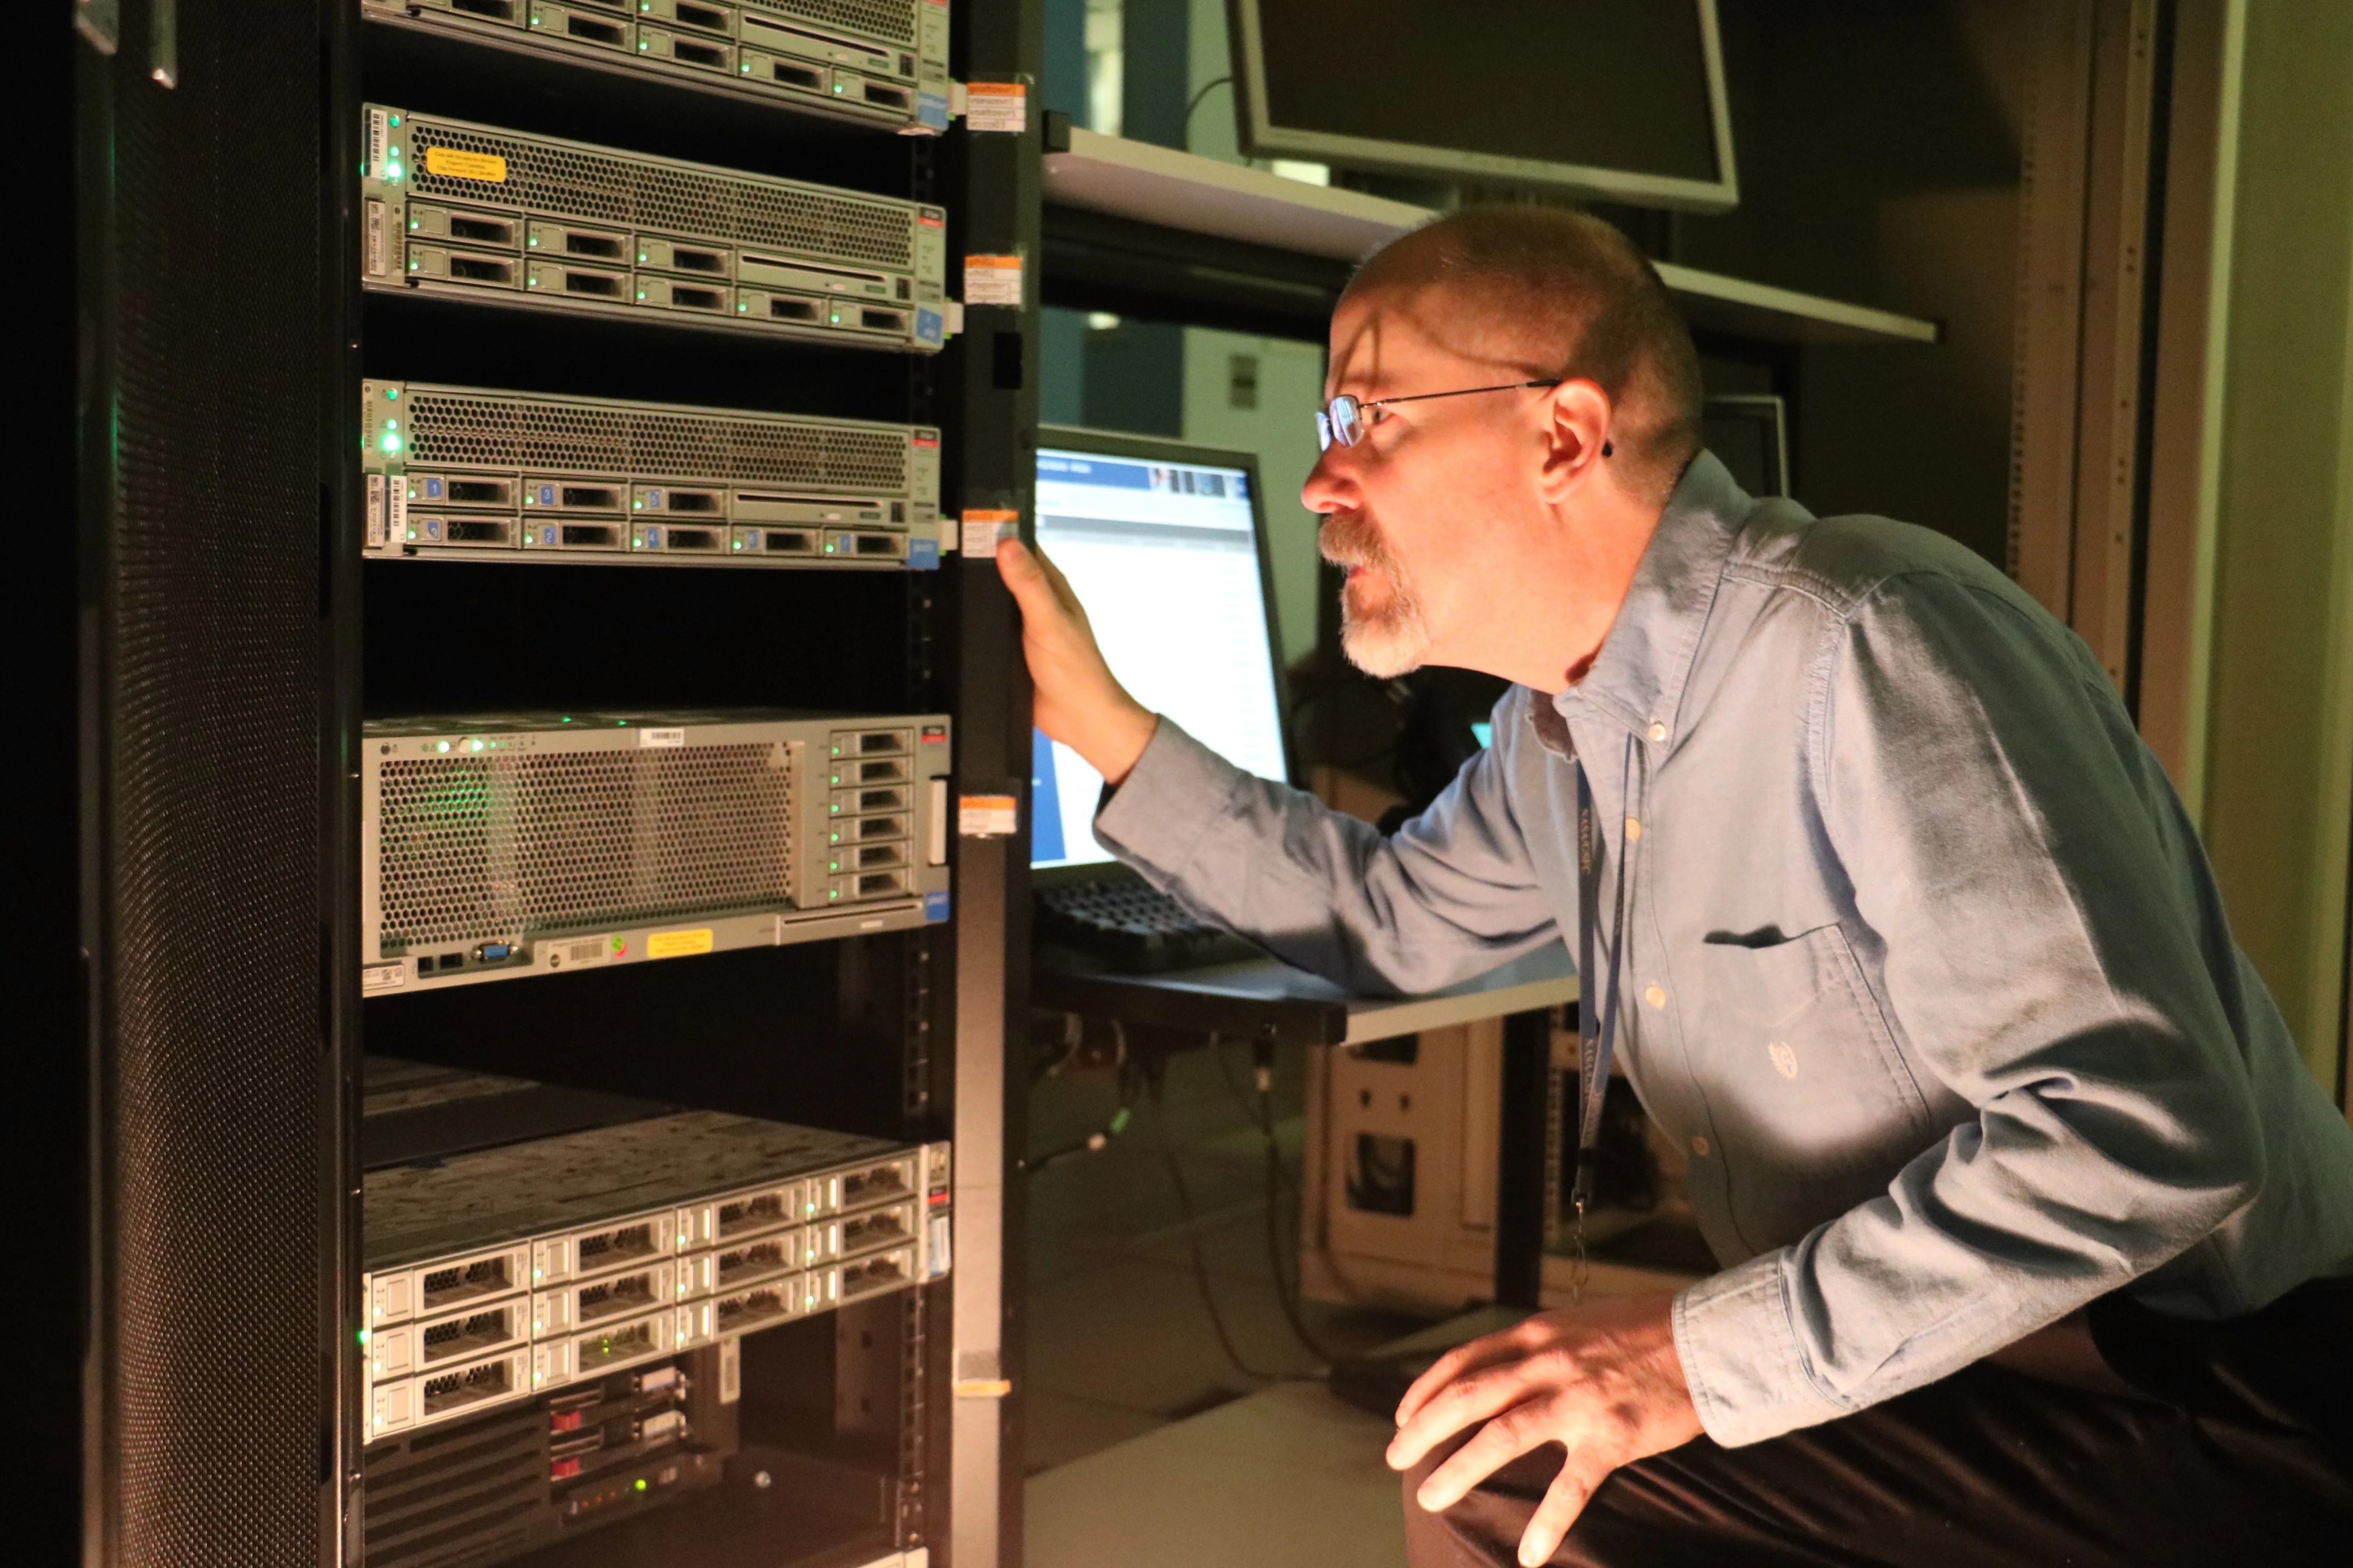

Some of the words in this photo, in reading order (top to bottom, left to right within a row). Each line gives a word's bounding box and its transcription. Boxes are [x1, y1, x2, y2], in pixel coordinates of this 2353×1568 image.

[432, 483, 437, 493] 1
[545, 489, 550, 499] 3
[546, 532, 552, 542] 2
